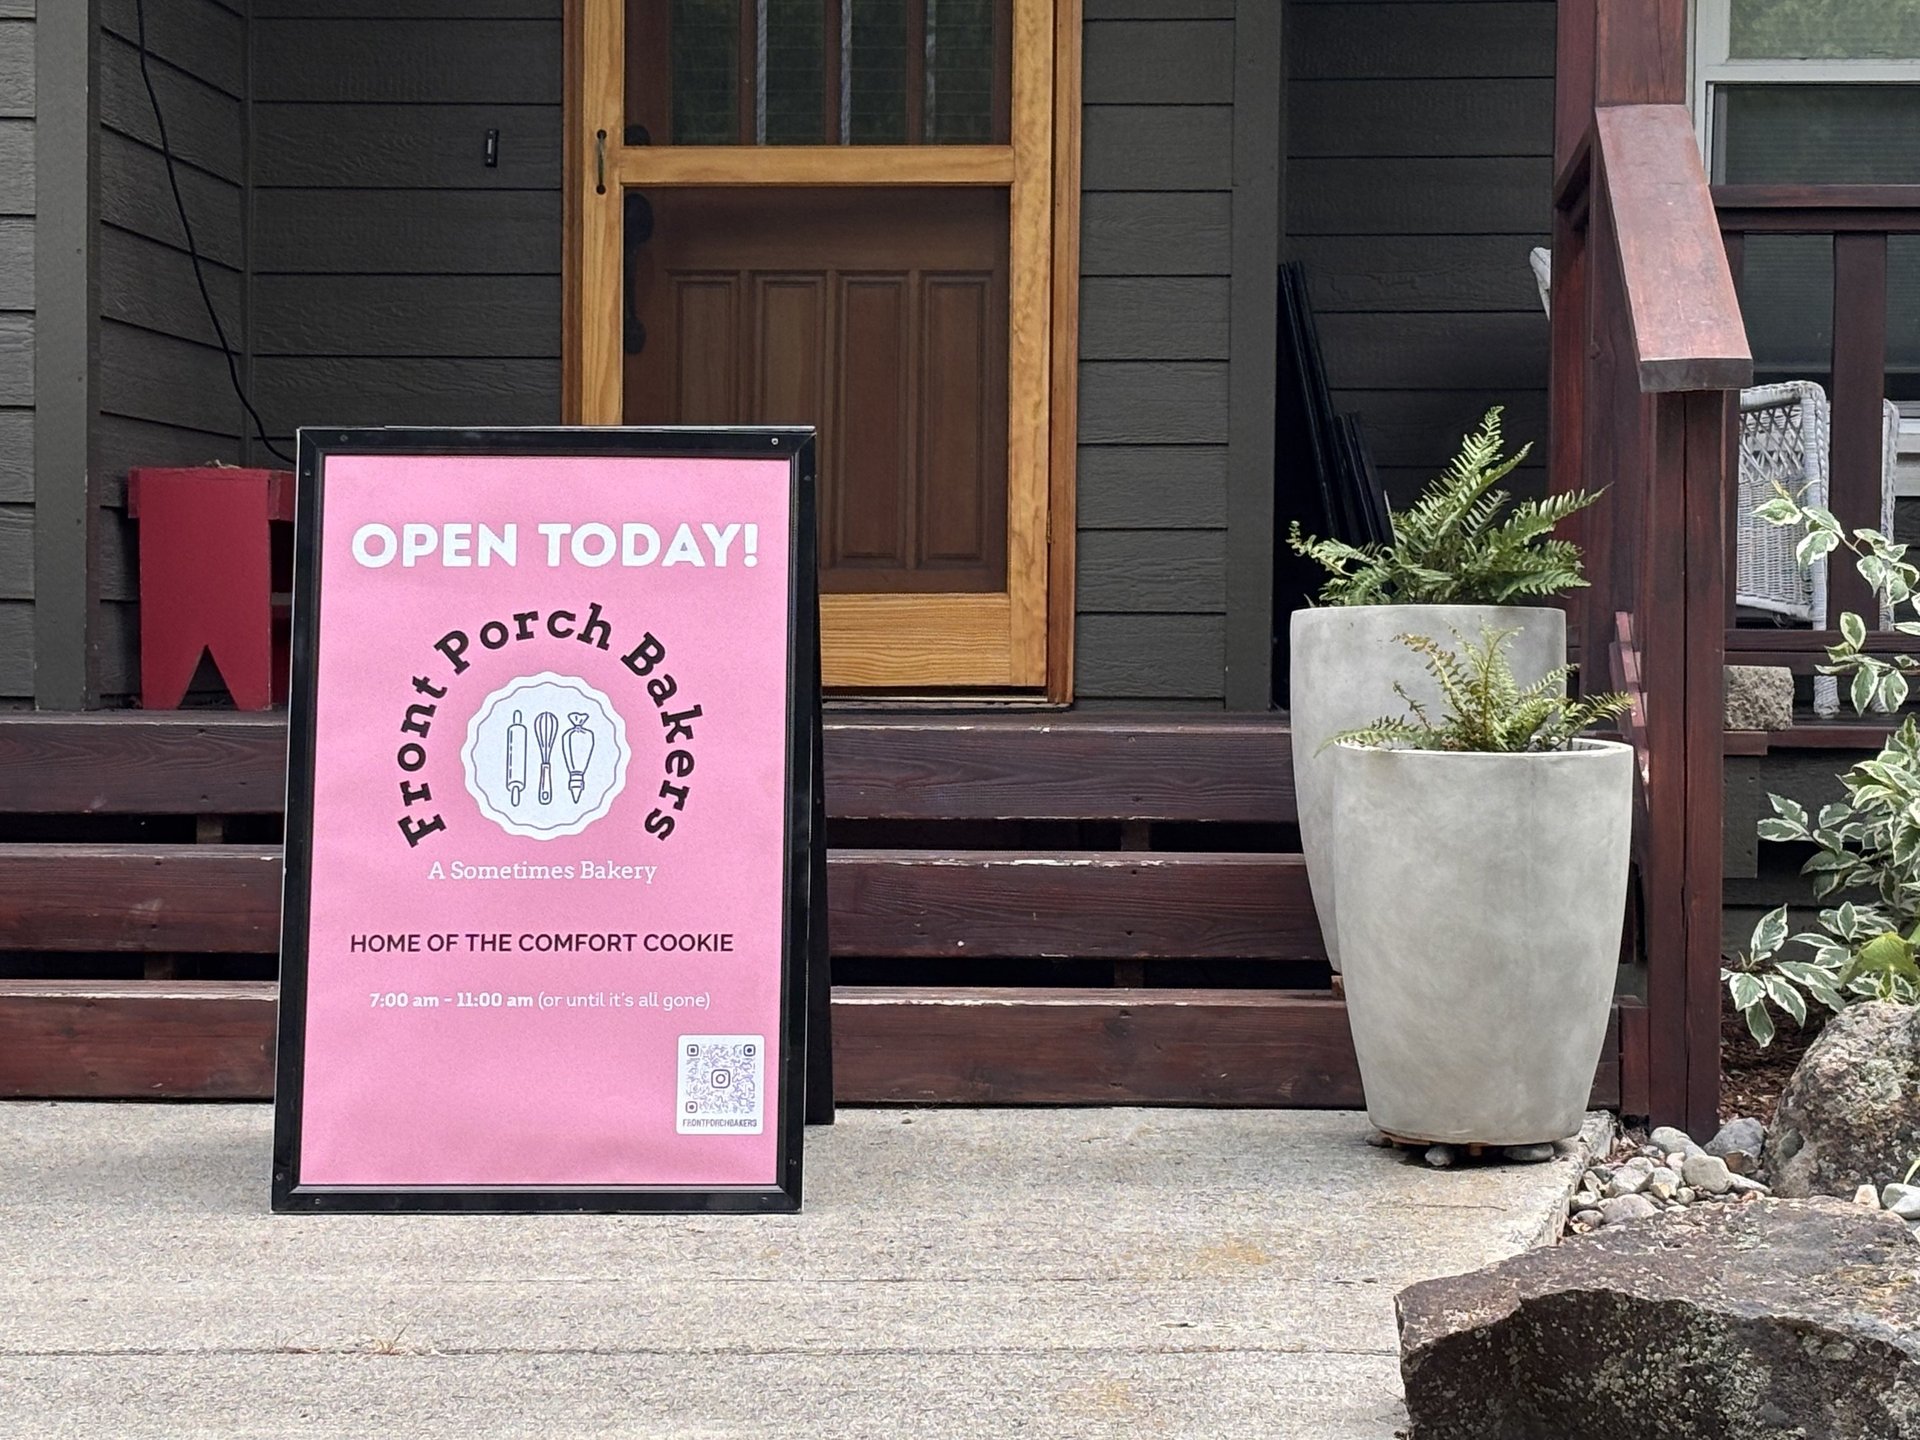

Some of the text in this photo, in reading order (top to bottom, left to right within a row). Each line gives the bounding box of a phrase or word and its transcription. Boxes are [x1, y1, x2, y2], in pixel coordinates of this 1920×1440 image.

[352, 522, 759, 569] OPEN TODAY!
[397, 602, 703, 848] Front Porch Bakers
[427, 860, 658, 884] A Sometimes Bakery
[350, 933, 734, 953] HOME OF THE COMFORT COOKIE
[369, 992, 409, 1008] 7:00
[412, 997, 440, 1008] am
[456, 992, 502, 1008] 11:00
[506, 996, 533, 1008] am
[538, 991, 563, 1010] (or
[566, 992, 604, 1008] until
[609, 992, 634, 1008] it's
[638, 992, 659, 1008] all
[663, 992, 711, 1012] gone)
